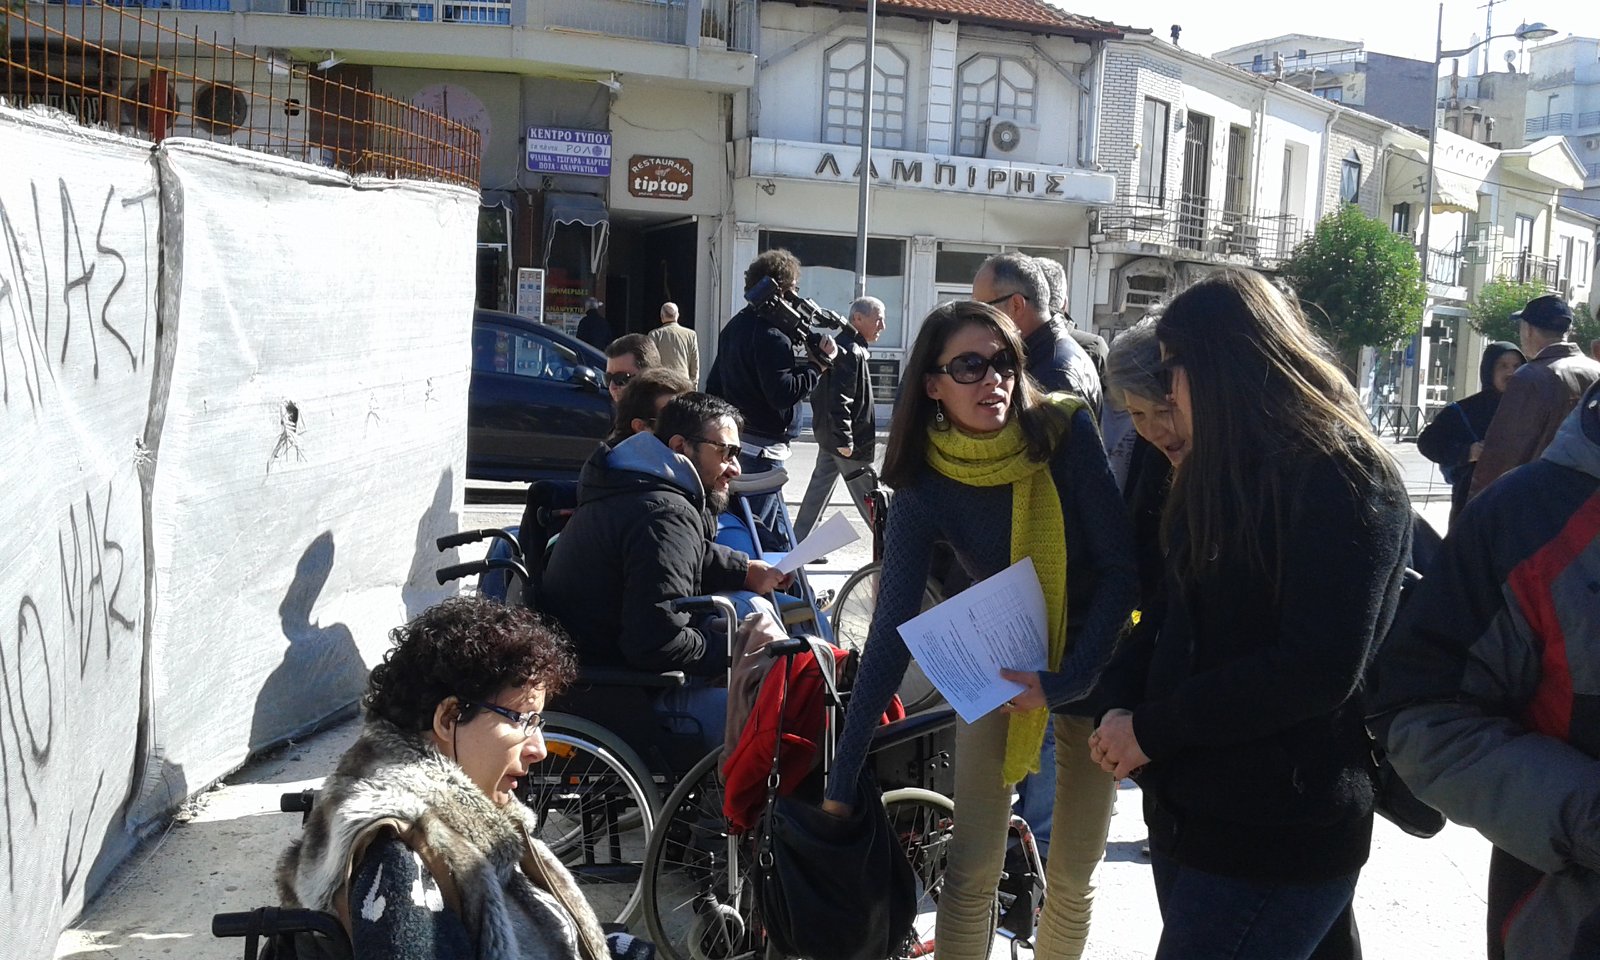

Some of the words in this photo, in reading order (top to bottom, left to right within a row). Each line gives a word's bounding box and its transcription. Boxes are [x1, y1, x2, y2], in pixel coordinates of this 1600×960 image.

[530, 128, 572, 141] ΚΕΝΤΡΟ
[575, 132, 609, 145] ΤΥΠΟΥ
[538, 161, 556, 170] ΠΟΤΑ
[556, 156, 582, 165] ΤΣΙΓΑΡΑ
[586, 158, 609, 167] ΚΑΡΤΕΣ
[631, 158, 691, 176] RESTAURANT
[815, 152, 1066, 196] ΛΑΜΠΙΡΗΣ
